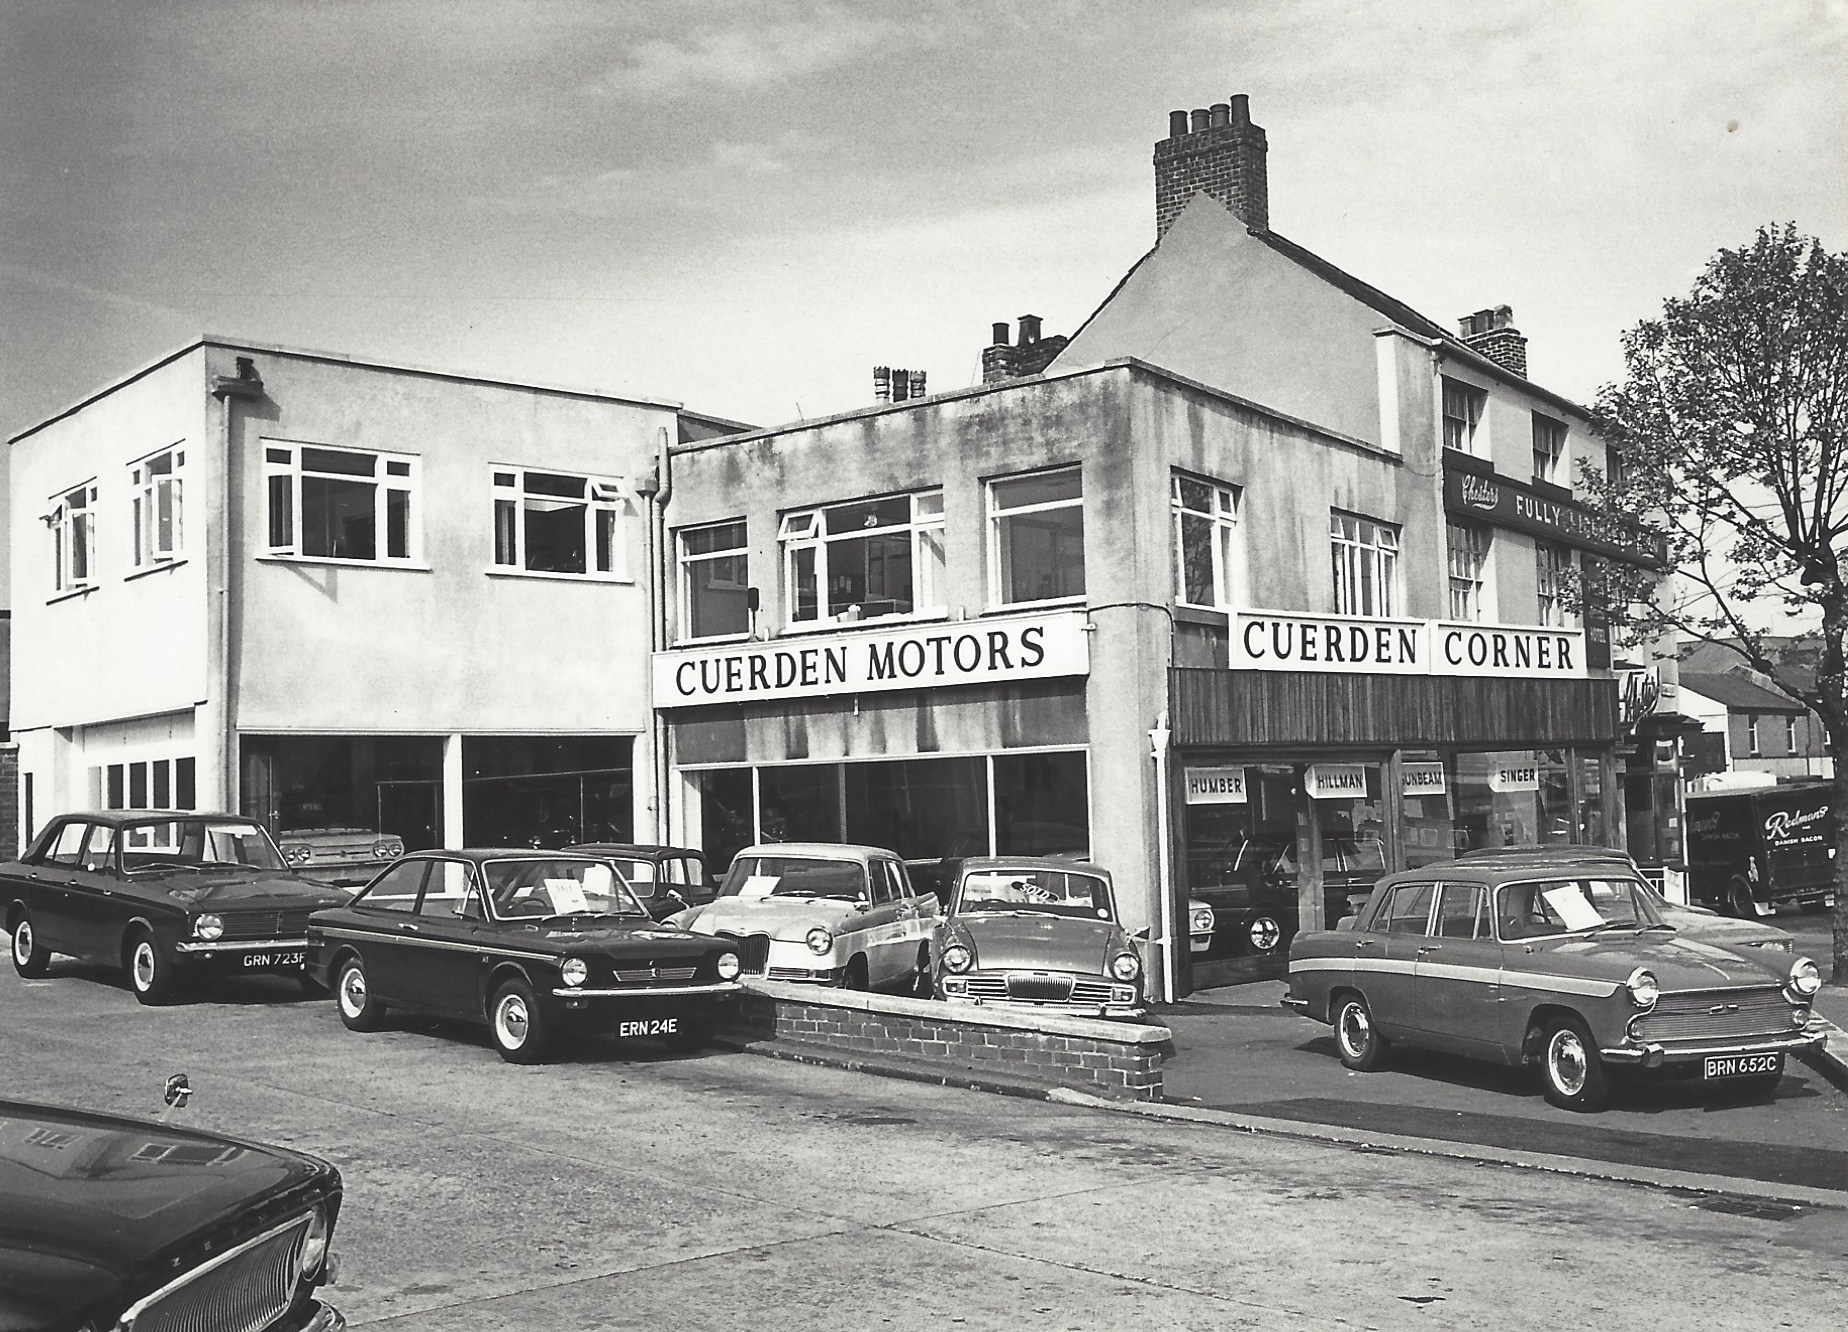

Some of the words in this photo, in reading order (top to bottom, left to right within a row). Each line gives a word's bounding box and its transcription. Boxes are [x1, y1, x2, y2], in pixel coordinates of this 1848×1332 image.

[1516, 495, 1561, 526] FULLY
[1243, 621, 1417, 664] CUERDEN
[1444, 631, 1574, 670] CORNER
[675, 646, 847, 696] CUERDEN
[866, 626, 1045, 681] MOTORS
[1317, 774, 1363, 789] HILLMAN
[1500, 768, 1535, 783] SINGER
[1191, 778, 1242, 794] HUMBER
[1775, 838, 1798, 846] DANISH
[1801, 835, 1823, 843] BACON
[1019, 883, 1050, 900] SOLD
[244, 954, 270, 967] GRN
[274, 952, 306, 965] 723F
[620, 1021, 648, 1037] ERN
[651, 1018, 677, 1034] 24E
[1708, 1060, 1735, 1076] BRN
[1739, 1056, 1776, 1073] 652C
